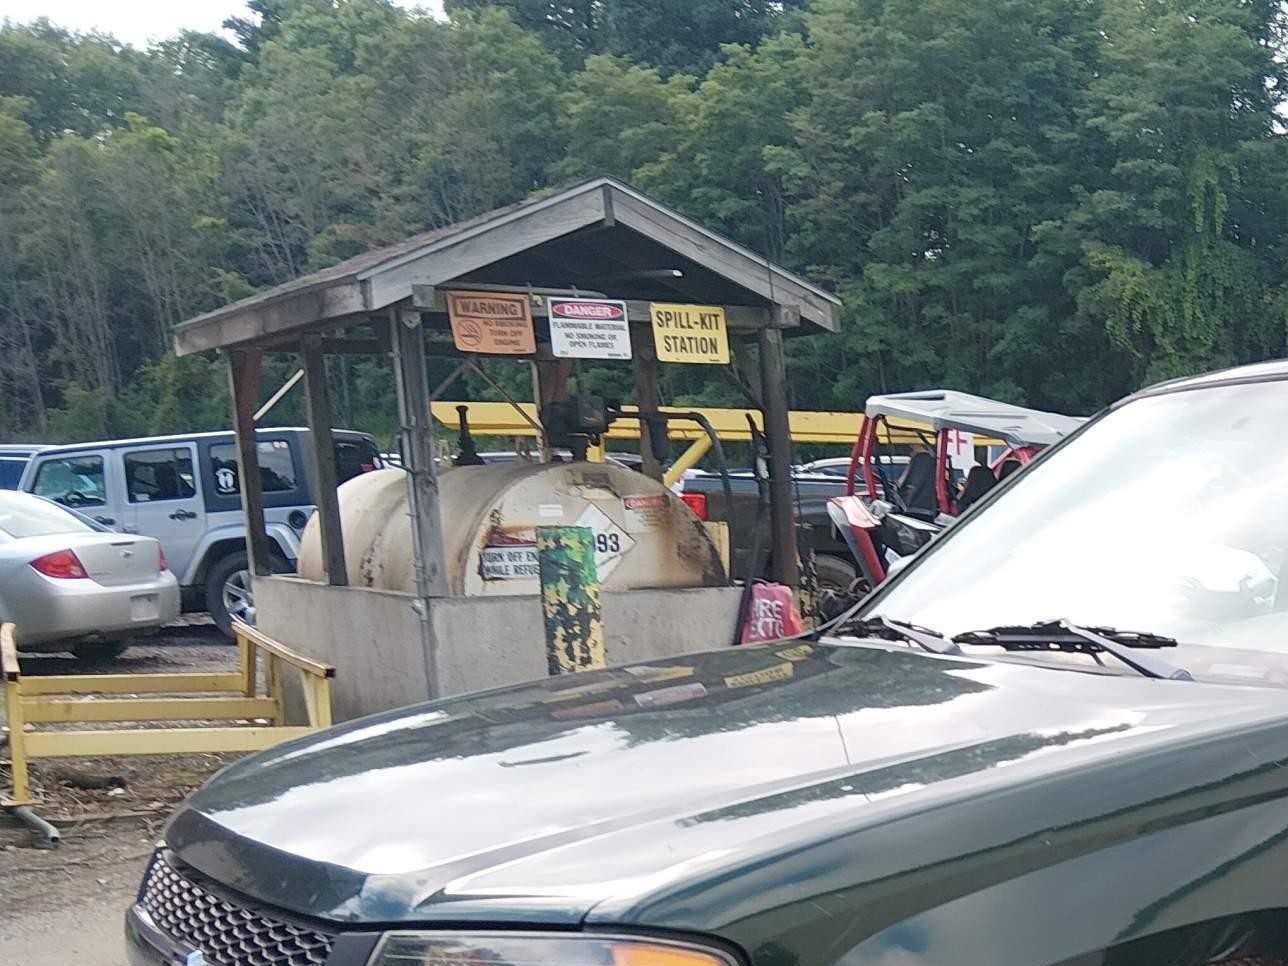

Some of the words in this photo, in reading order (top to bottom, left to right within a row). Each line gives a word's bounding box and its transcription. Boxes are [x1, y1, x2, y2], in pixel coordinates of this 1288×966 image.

[460, 301, 518, 315] WARNING
[564, 304, 612, 317] DANGER
[656, 311, 720, 330] SPILL-KIT
[576, 332, 606, 340] SMOKING
[664, 335, 719, 354] STATION
[592, 533, 620, 552] 93
[507, 551, 521, 562] OFF
